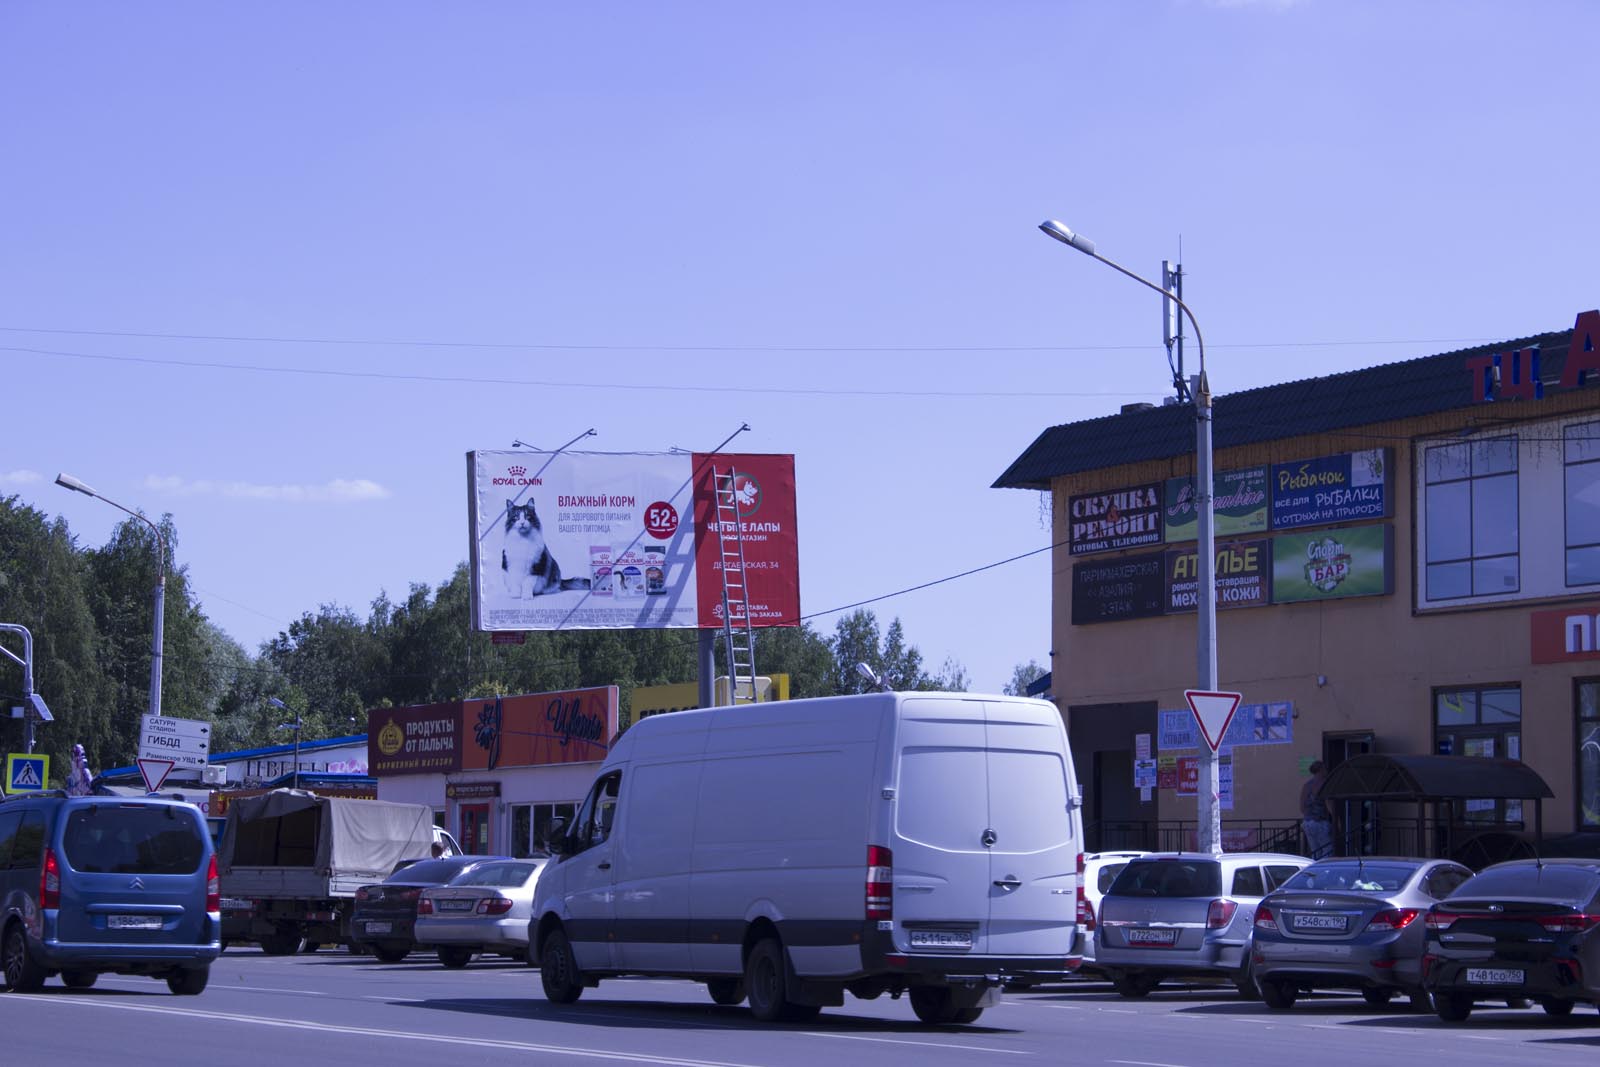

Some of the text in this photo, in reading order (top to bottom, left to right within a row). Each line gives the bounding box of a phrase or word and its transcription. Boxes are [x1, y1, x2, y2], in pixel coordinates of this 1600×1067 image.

[1465, 348, 1543, 402] ТЦ
[492, 478, 543, 486] ROYAL CANIN
[1278, 464, 1345, 491] Рыбачок
[558, 494, 635, 508] ВЛАЖНЫЙ КОРМ
[1073, 488, 1157, 518] СКУПКА
[1315, 487, 1380, 507] РЫБАЛКИ
[558, 511, 632, 522] ДЛЯ ЗДОРОВОГО ПИТАНИЯ
[650, 508, 671, 528] 52
[1282, 510, 1320, 524] ОТДЫХА
[1322, 508, 1334, 519] НА
[1336, 502, 1382, 518] ПРИРОДЕ
[558, 524, 611, 534] ВАШЕГО ПИТОМЦА
[748, 522, 782, 532] ЛАПЫ
[1073, 512, 1159, 542] РЕМОНТ
[1073, 533, 1159, 553] СОТОВЫХ ТЕЛЕФОНОВ
[1307, 541, 1345, 560] Спорт
[769, 561, 779, 569] 34
[1173, 547, 1258, 579] АТЛЬЕ
[1315, 563, 1345, 582] БАР
[1172, 591, 1199, 607] мех
[1223, 586, 1260, 602] кожи
[1565, 614, 1600, 653] П
[149, 718, 176, 727] САТУРН
[149, 725, 176, 733] стадион
[406, 719, 454, 736] ПРОДУКТЫ
[147, 735, 181, 749] ГИБДД
[405, 739, 417, 753] ОТ
[418, 737, 454, 752] ПАЛЫЧА
[146, 752, 196, 764] Раменское УВД
[421, 757, 453, 767] МАГАЗИН
[1294, 915, 1330, 926] У548СХ
